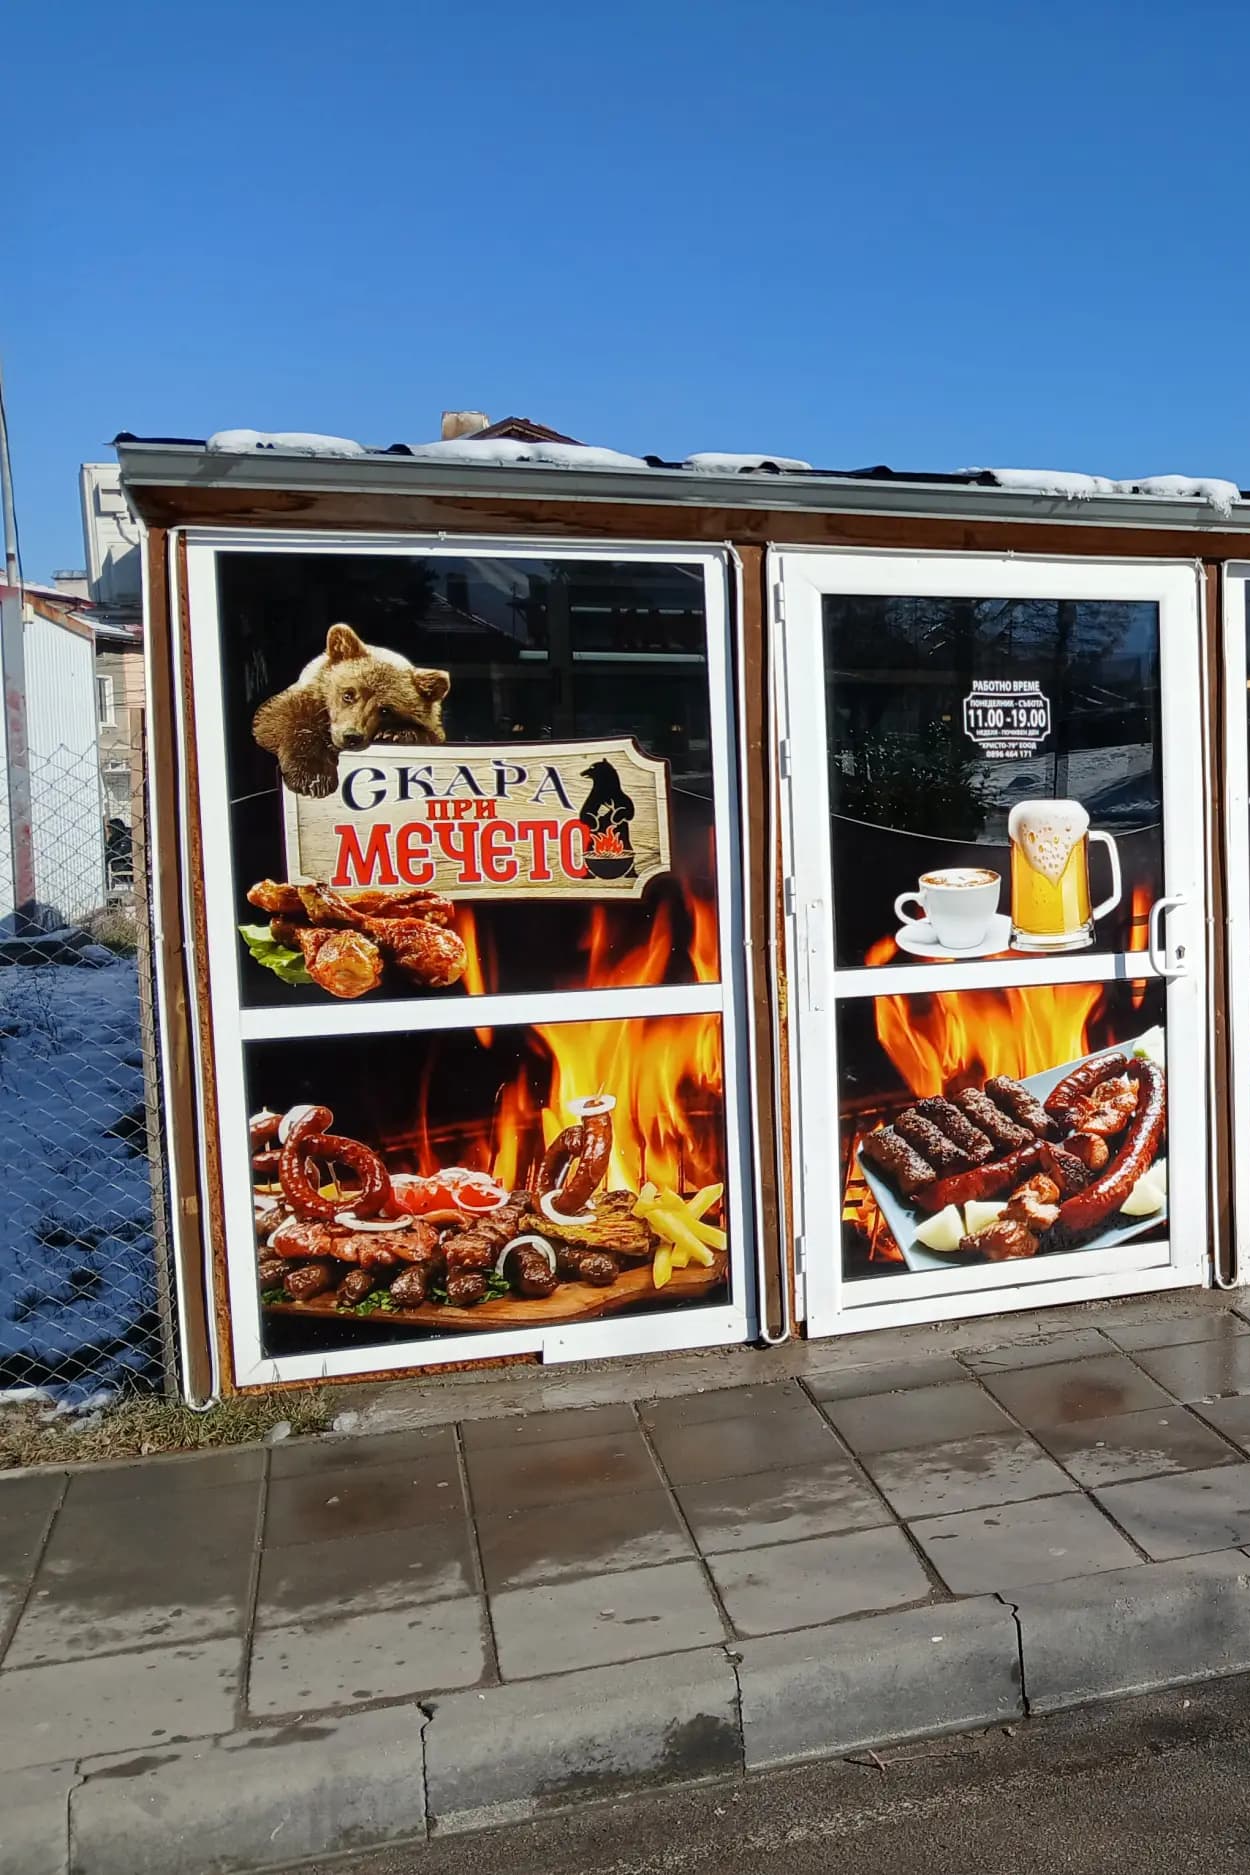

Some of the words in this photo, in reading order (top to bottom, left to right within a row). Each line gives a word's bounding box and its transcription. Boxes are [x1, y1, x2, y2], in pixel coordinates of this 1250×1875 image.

[972, 681, 1011, 692] РАБОТНО
[1013, 681, 1040, 692] ВРЕМЕ
[970, 700, 1014, 708] ПОНЕДЕЛНИК
[968, 709, 1004, 727] 11.00
[342, 759, 576, 811] СКАРА
[425, 799, 498, 820] ПРИ
[331, 820, 591, 887] МЕЧЕТО
